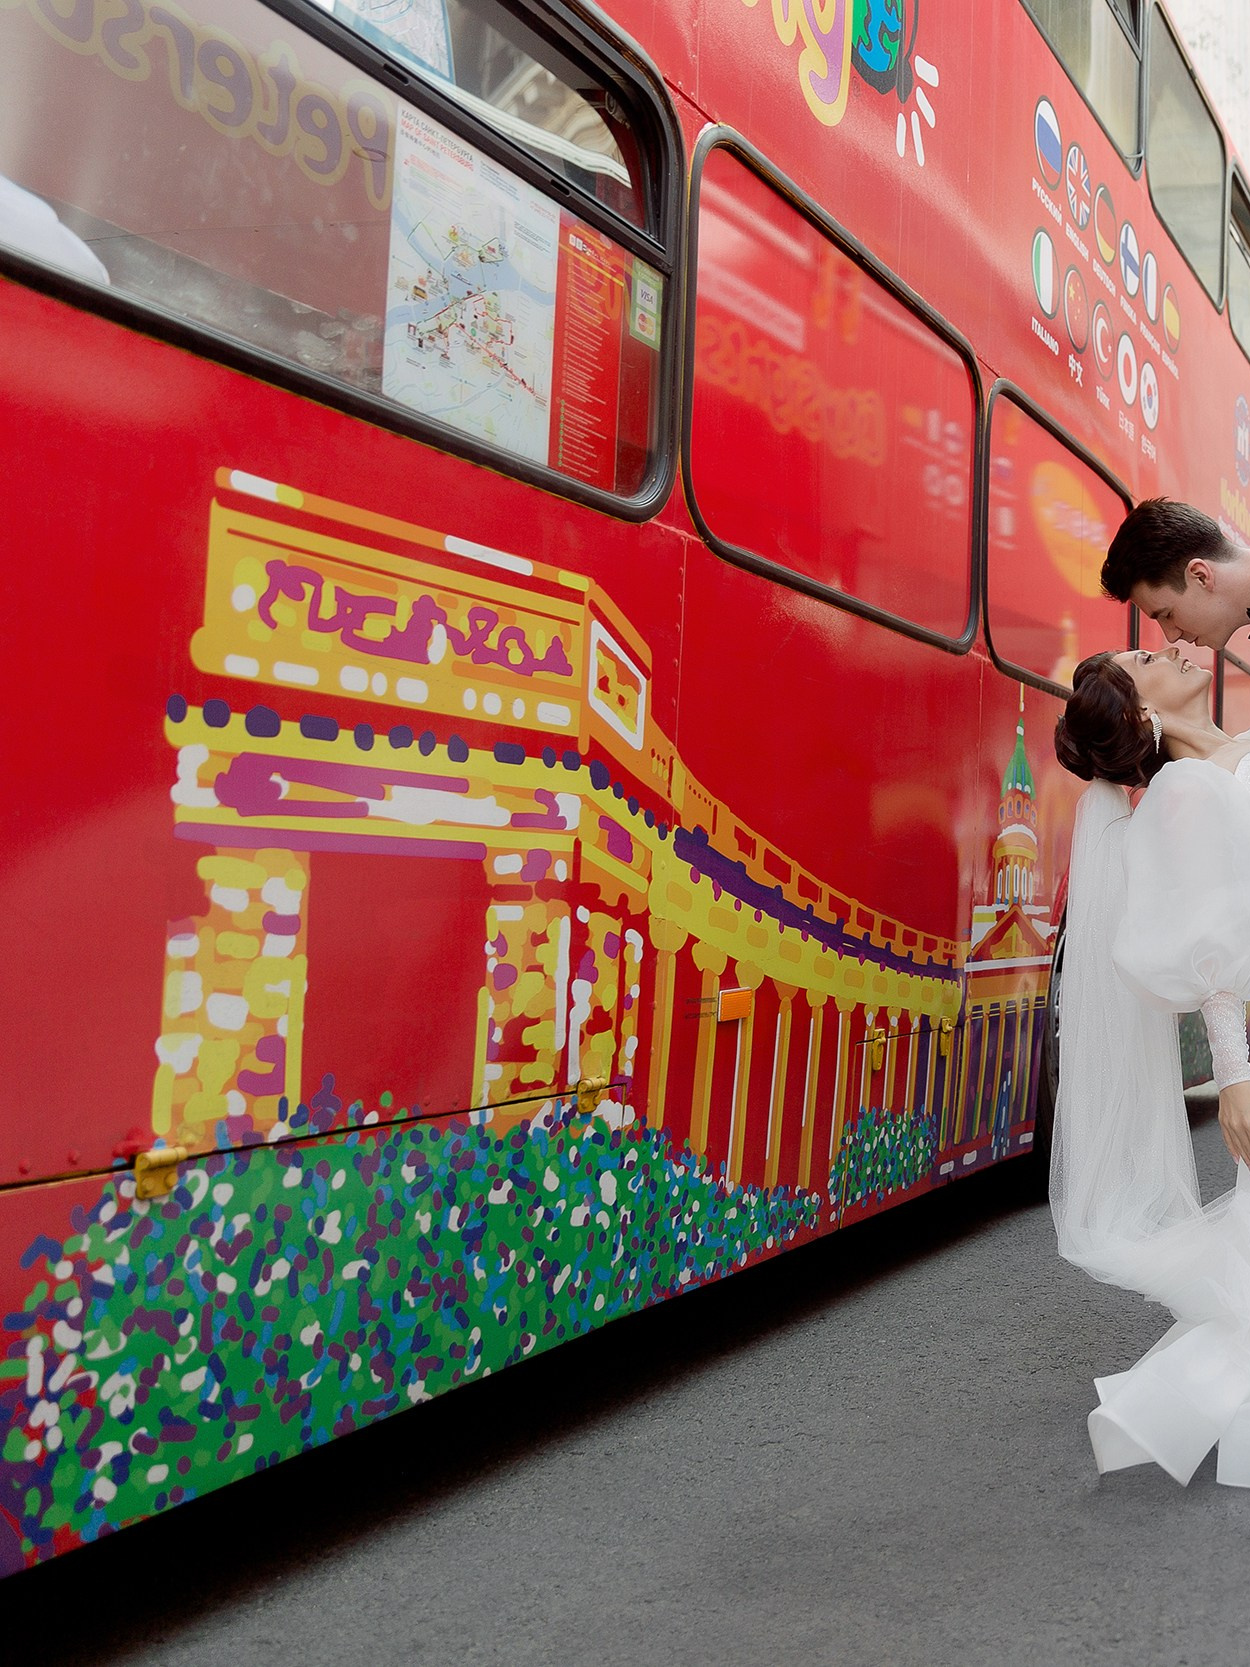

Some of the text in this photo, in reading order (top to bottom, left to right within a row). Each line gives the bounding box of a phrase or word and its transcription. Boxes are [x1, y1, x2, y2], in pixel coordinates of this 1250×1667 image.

[1031, 176, 1063, 227] РУССКИЙ
[1065, 221, 1090, 262] ENGLISH
[640, 288, 655, 305] VISA
[1092, 258, 1116, 297] DEUTSCH
[1031, 316, 1060, 356] ITALIANO
[1068, 353, 1084, 388] 中文
